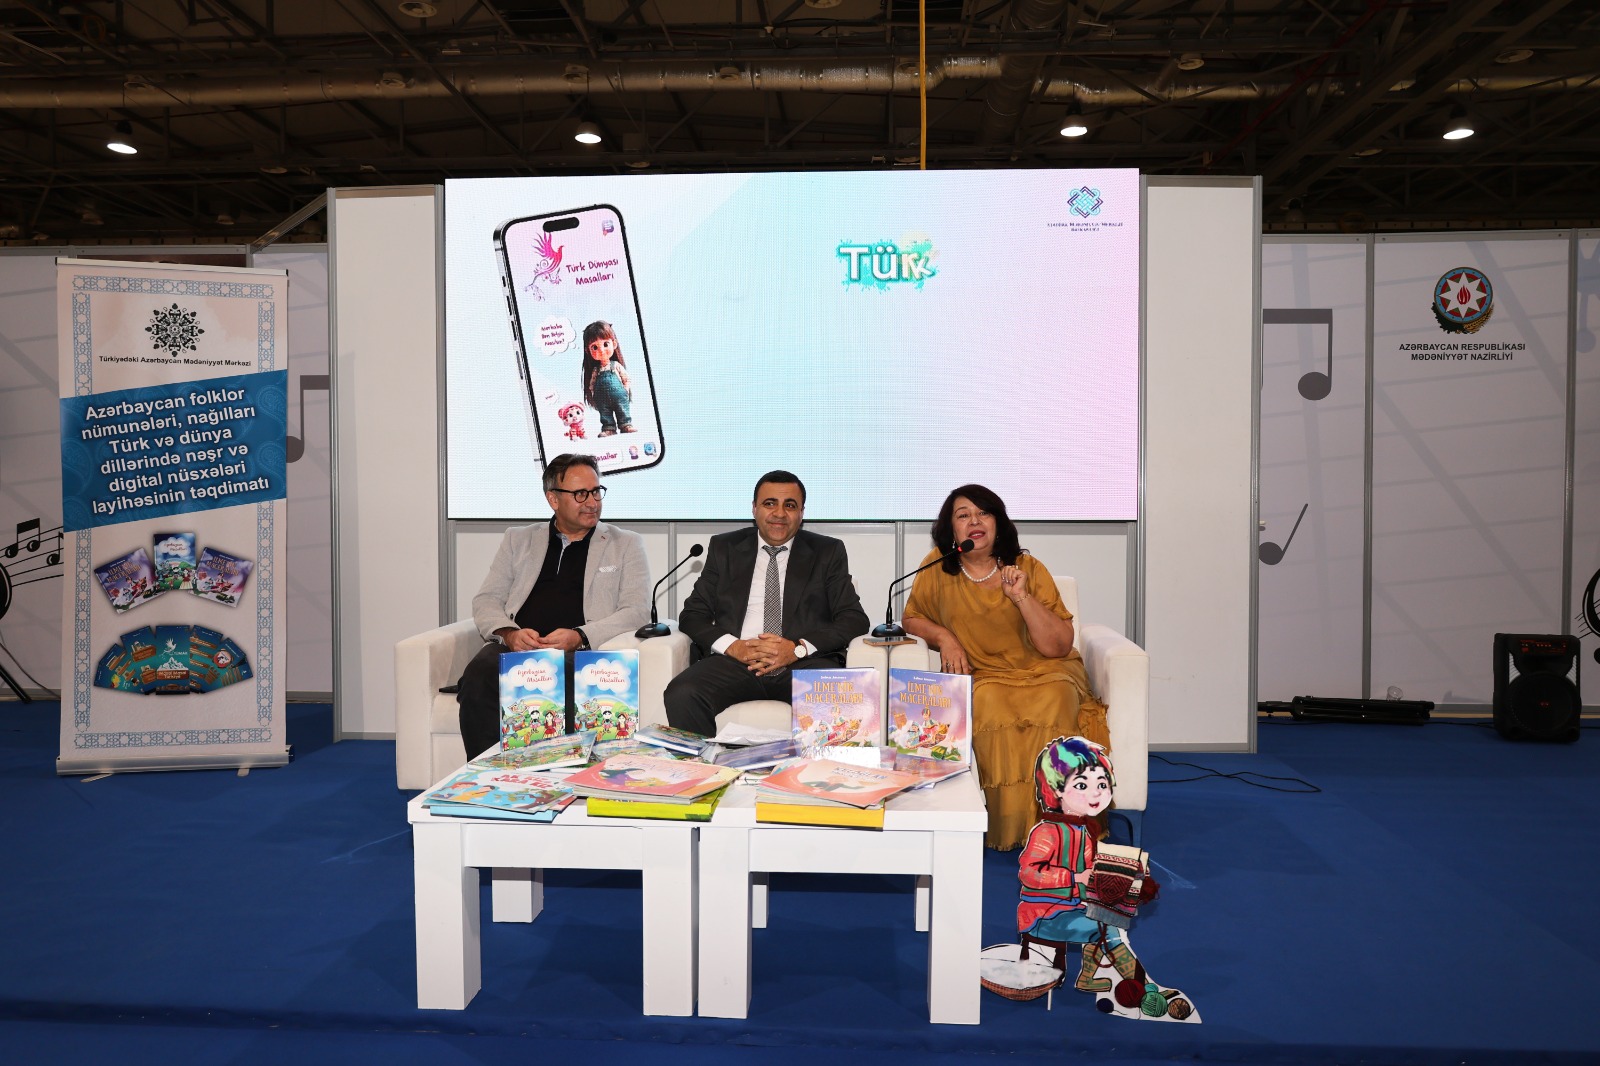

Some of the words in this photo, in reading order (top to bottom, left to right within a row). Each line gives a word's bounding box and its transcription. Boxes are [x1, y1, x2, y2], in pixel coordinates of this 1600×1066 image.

[565, 261, 586, 273] Türk
[587, 258, 619, 269] Dünyası
[575, 271, 614, 285] Masalları
[1398, 343, 1459, 351] AZƏRBAYCAN
[1460, 341, 1526, 351] RESPUBLİKASI
[1411, 352, 1469, 361] MƏDƏNİYYƏT
[1470, 351, 1513, 361] NAZİRLİYİ
[140, 356, 182, 366] Azərbaycan
[183, 358, 223, 366] Mədəniyyət
[224, 359, 252, 367] Mərkəzi
[85, 396, 186, 421] Azərbaycan
[189, 388, 245, 406] folklor
[81, 413, 183, 440] nümunələri,
[187, 406, 255, 426] nağılları
[109, 436, 150, 454] Türk
[154, 436, 175, 448] və
[179, 427, 233, 445] dünya
[100, 452, 181, 475] dillərində
[185, 447, 224, 462] nəşr
[227, 444, 249, 457] və
[108, 472, 163, 493] digital
[167, 460, 246, 484] nüsxələri
[92, 489, 186, 515] layihəsinin
[189, 476, 270, 501] təqdimatı
